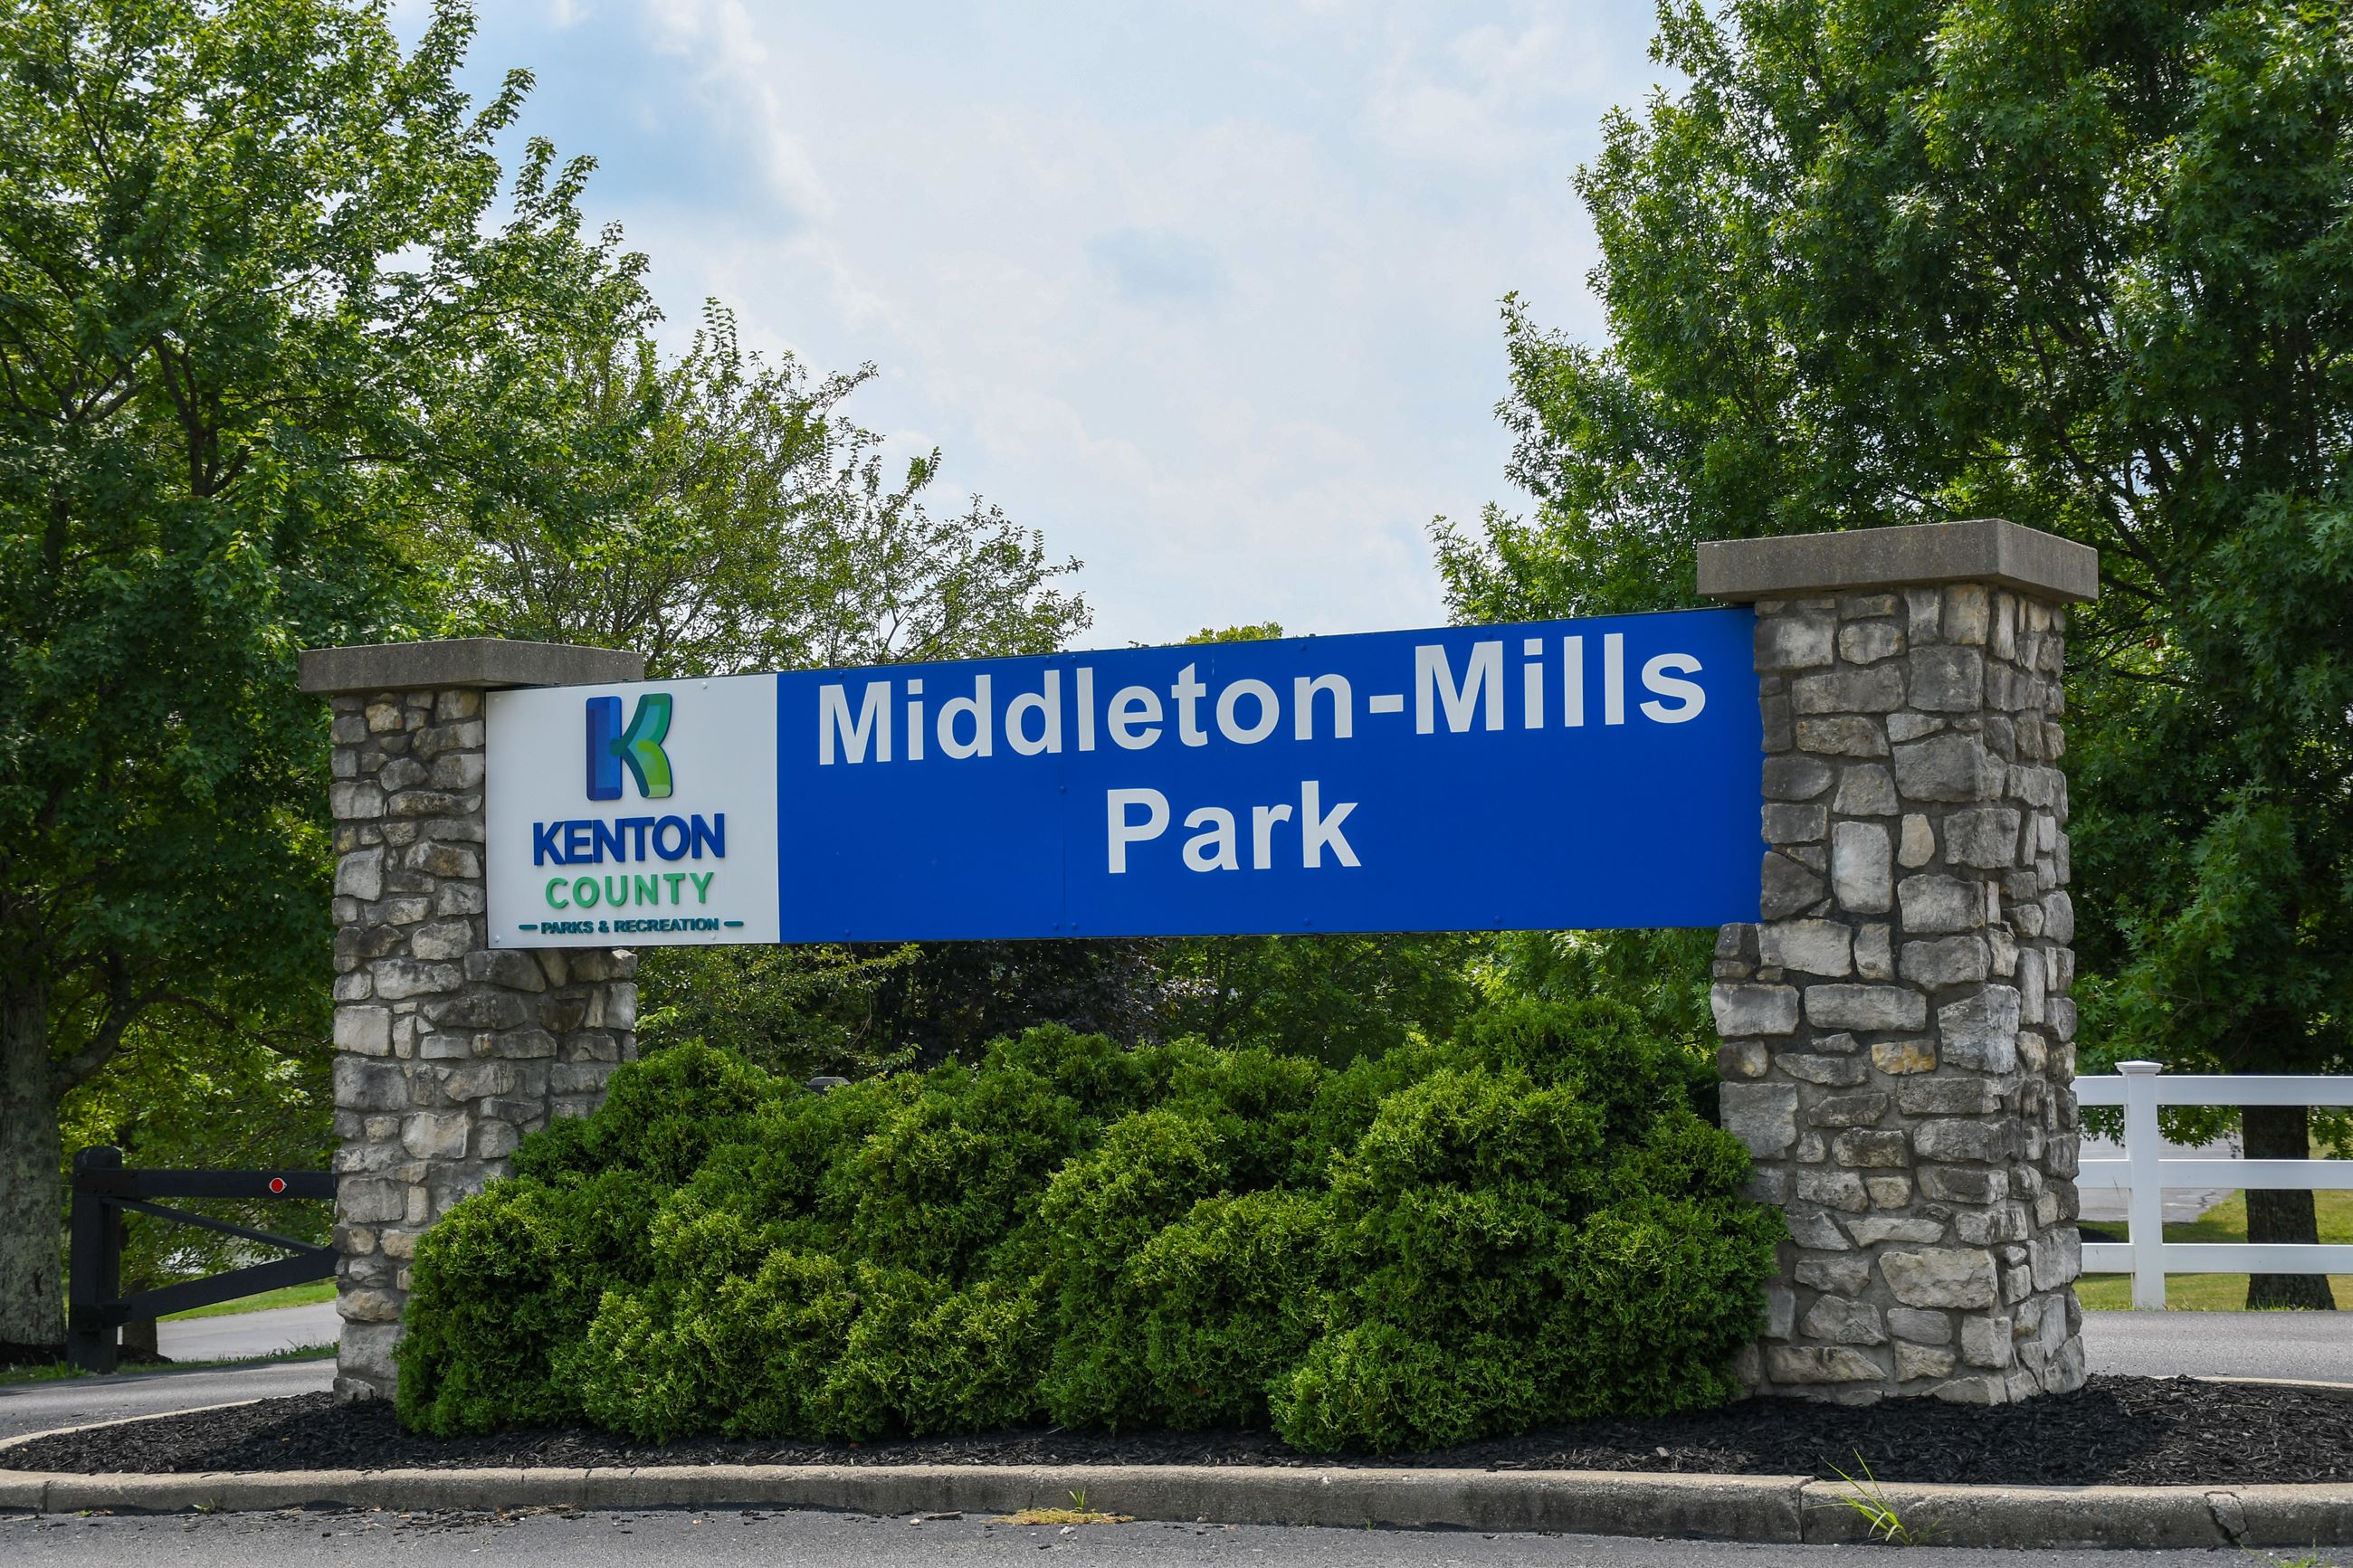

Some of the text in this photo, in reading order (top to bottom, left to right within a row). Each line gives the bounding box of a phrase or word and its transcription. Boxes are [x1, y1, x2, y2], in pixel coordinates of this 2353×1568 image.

[819, 632, 1706, 765] Middleton-Mills
[533, 813, 725, 866] KENTON
[1107, 780, 1361, 874] Park
[545, 871, 715, 909] COUNTY
[540, 917, 719, 934] PARKS & RECREATION
